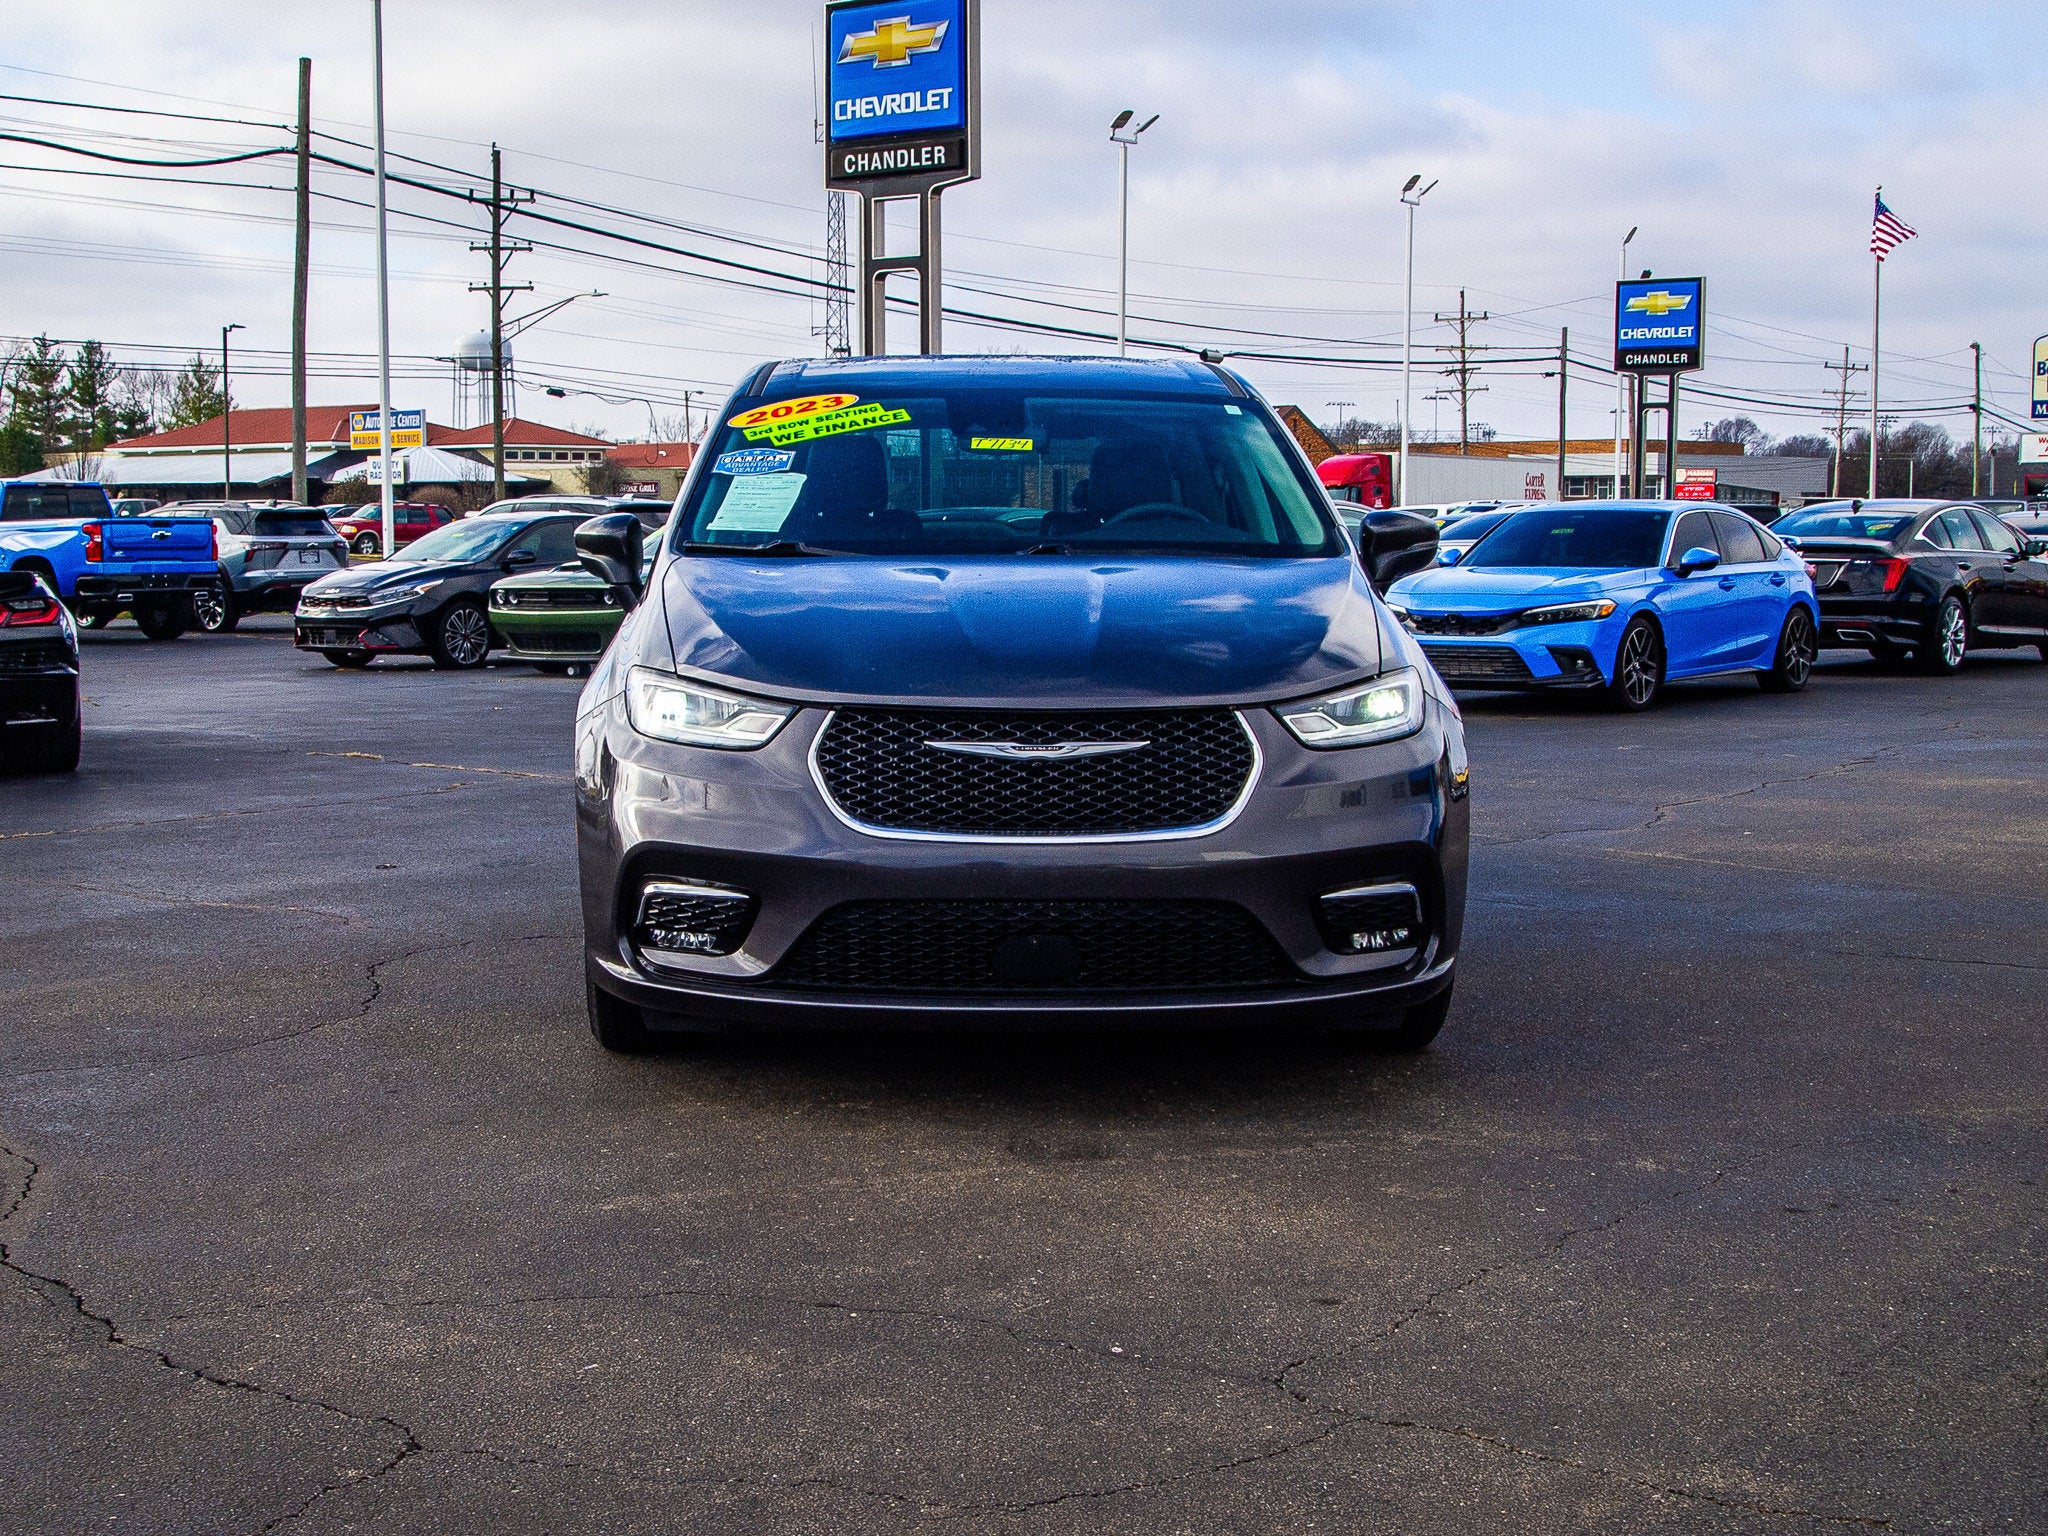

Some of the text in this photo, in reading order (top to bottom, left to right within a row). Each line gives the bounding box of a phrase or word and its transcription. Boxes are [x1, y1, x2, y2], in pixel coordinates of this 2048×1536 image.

[835, 88, 952, 121] CHEVROLET
[844, 146, 946, 173] CHANDLER
[1620, 326, 1694, 339] CHEVROLET
[1625, 353, 1688, 365] CHANDLER
[746, 396, 844, 425] 2023
[749, 406, 879, 438] 3rd ROW SEATING
[774, 412, 905, 443] WE FINANCE
[725, 461, 779, 469] ADVANTAGE
[1525, 472, 1545, 488] CARTER
